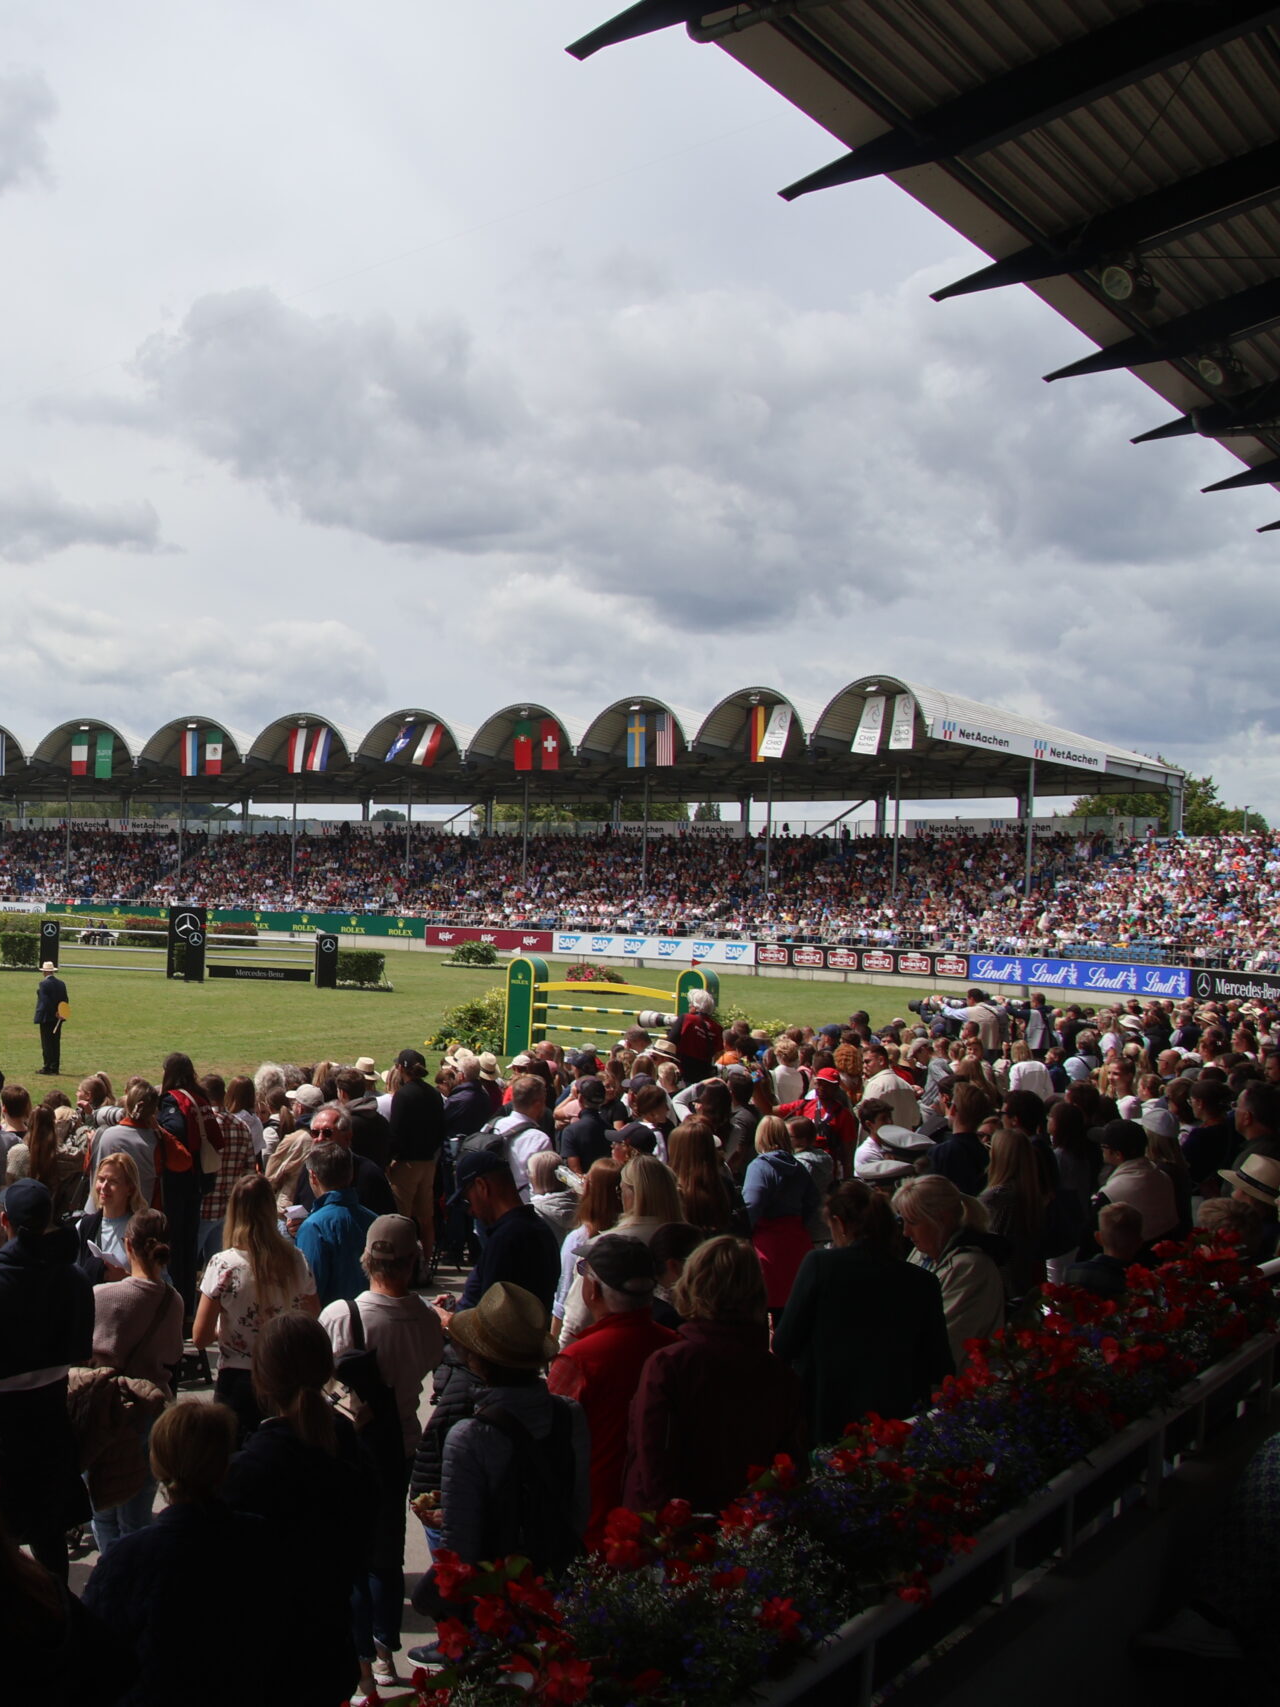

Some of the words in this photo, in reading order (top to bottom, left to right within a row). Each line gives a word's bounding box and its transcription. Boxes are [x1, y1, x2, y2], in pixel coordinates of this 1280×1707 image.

[959, 728, 1010, 748] NetAachen
[1050, 747, 1098, 766] NetAachen
[72, 821, 108, 829] NetAache
[395, 824, 435, 832] NetAahen
[691, 825, 734, 834] NetAachen
[928, 824, 974, 833] NetAachen
[1005, 823, 1052, 832] Netchen
[292, 924, 317, 932] ROLEX
[340, 926, 365, 934] ROLEX
[388, 928, 413, 937] ROLEX
[559, 937, 577, 948] SAP
[592, 939, 609, 949] SAP
[624, 940, 641, 951] SAP
[659, 942, 676, 953] SAP
[693, 944, 710, 955] SAP
[726, 946, 743, 957] SAP
[235, 968, 285, 979] Mercedes-Benz
[972, 959, 1013, 981] Lindt
[1028, 962, 1068, 984] Lindt
[1084, 967, 1127, 989] Lindt
[1142, 971, 1177, 994] Lindt
[1215, 978, 1280, 1000] Mercedes-Ben
